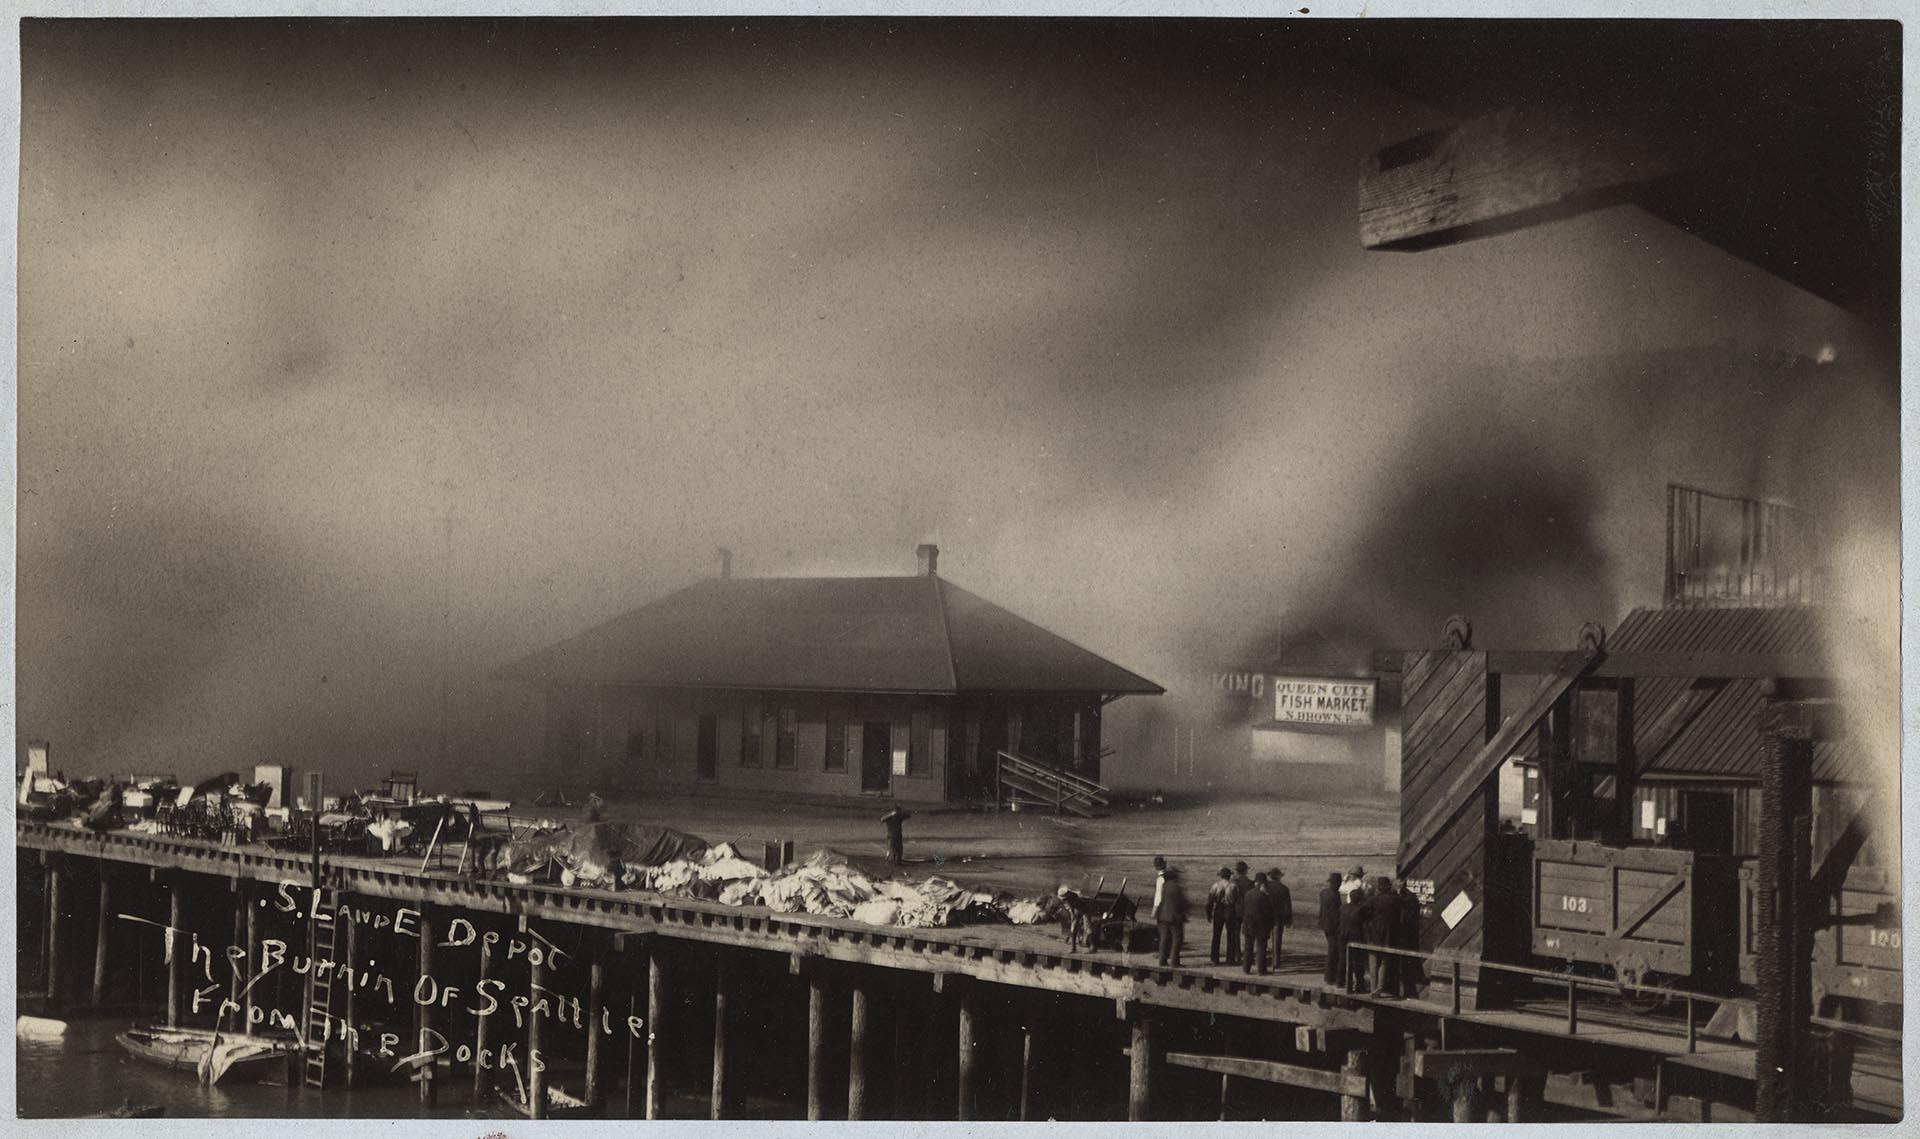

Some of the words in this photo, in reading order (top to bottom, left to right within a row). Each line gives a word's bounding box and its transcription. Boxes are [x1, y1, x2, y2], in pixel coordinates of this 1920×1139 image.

[1277, 683, 1327, 695] QUEEN
[1332, 685, 1369, 696] CITY
[1281, 694, 1312, 709] FISH
